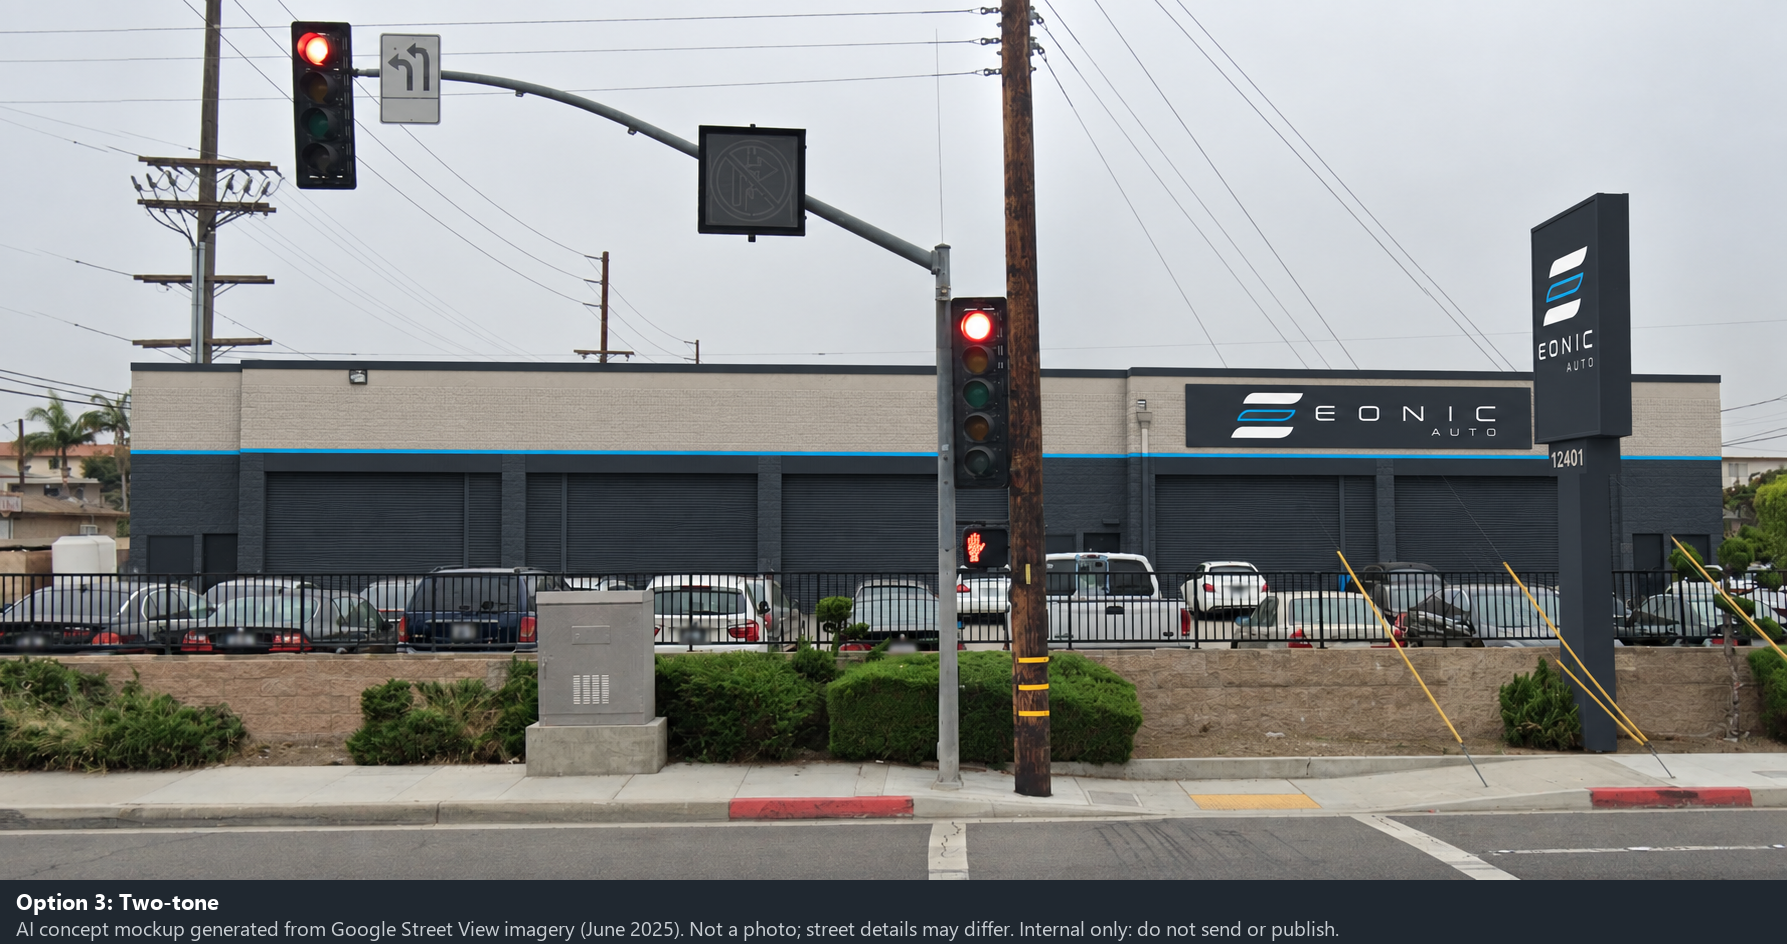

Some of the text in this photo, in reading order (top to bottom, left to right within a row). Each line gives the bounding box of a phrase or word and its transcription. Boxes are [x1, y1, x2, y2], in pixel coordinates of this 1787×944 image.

[1538, 329, 1593, 360] EONIC
[1566, 357, 1594, 372] AUTO
[1315, 405, 1496, 422] EONIC
[1431, 428, 1497, 437] AUTO
[1551, 449, 1584, 468] 12401
